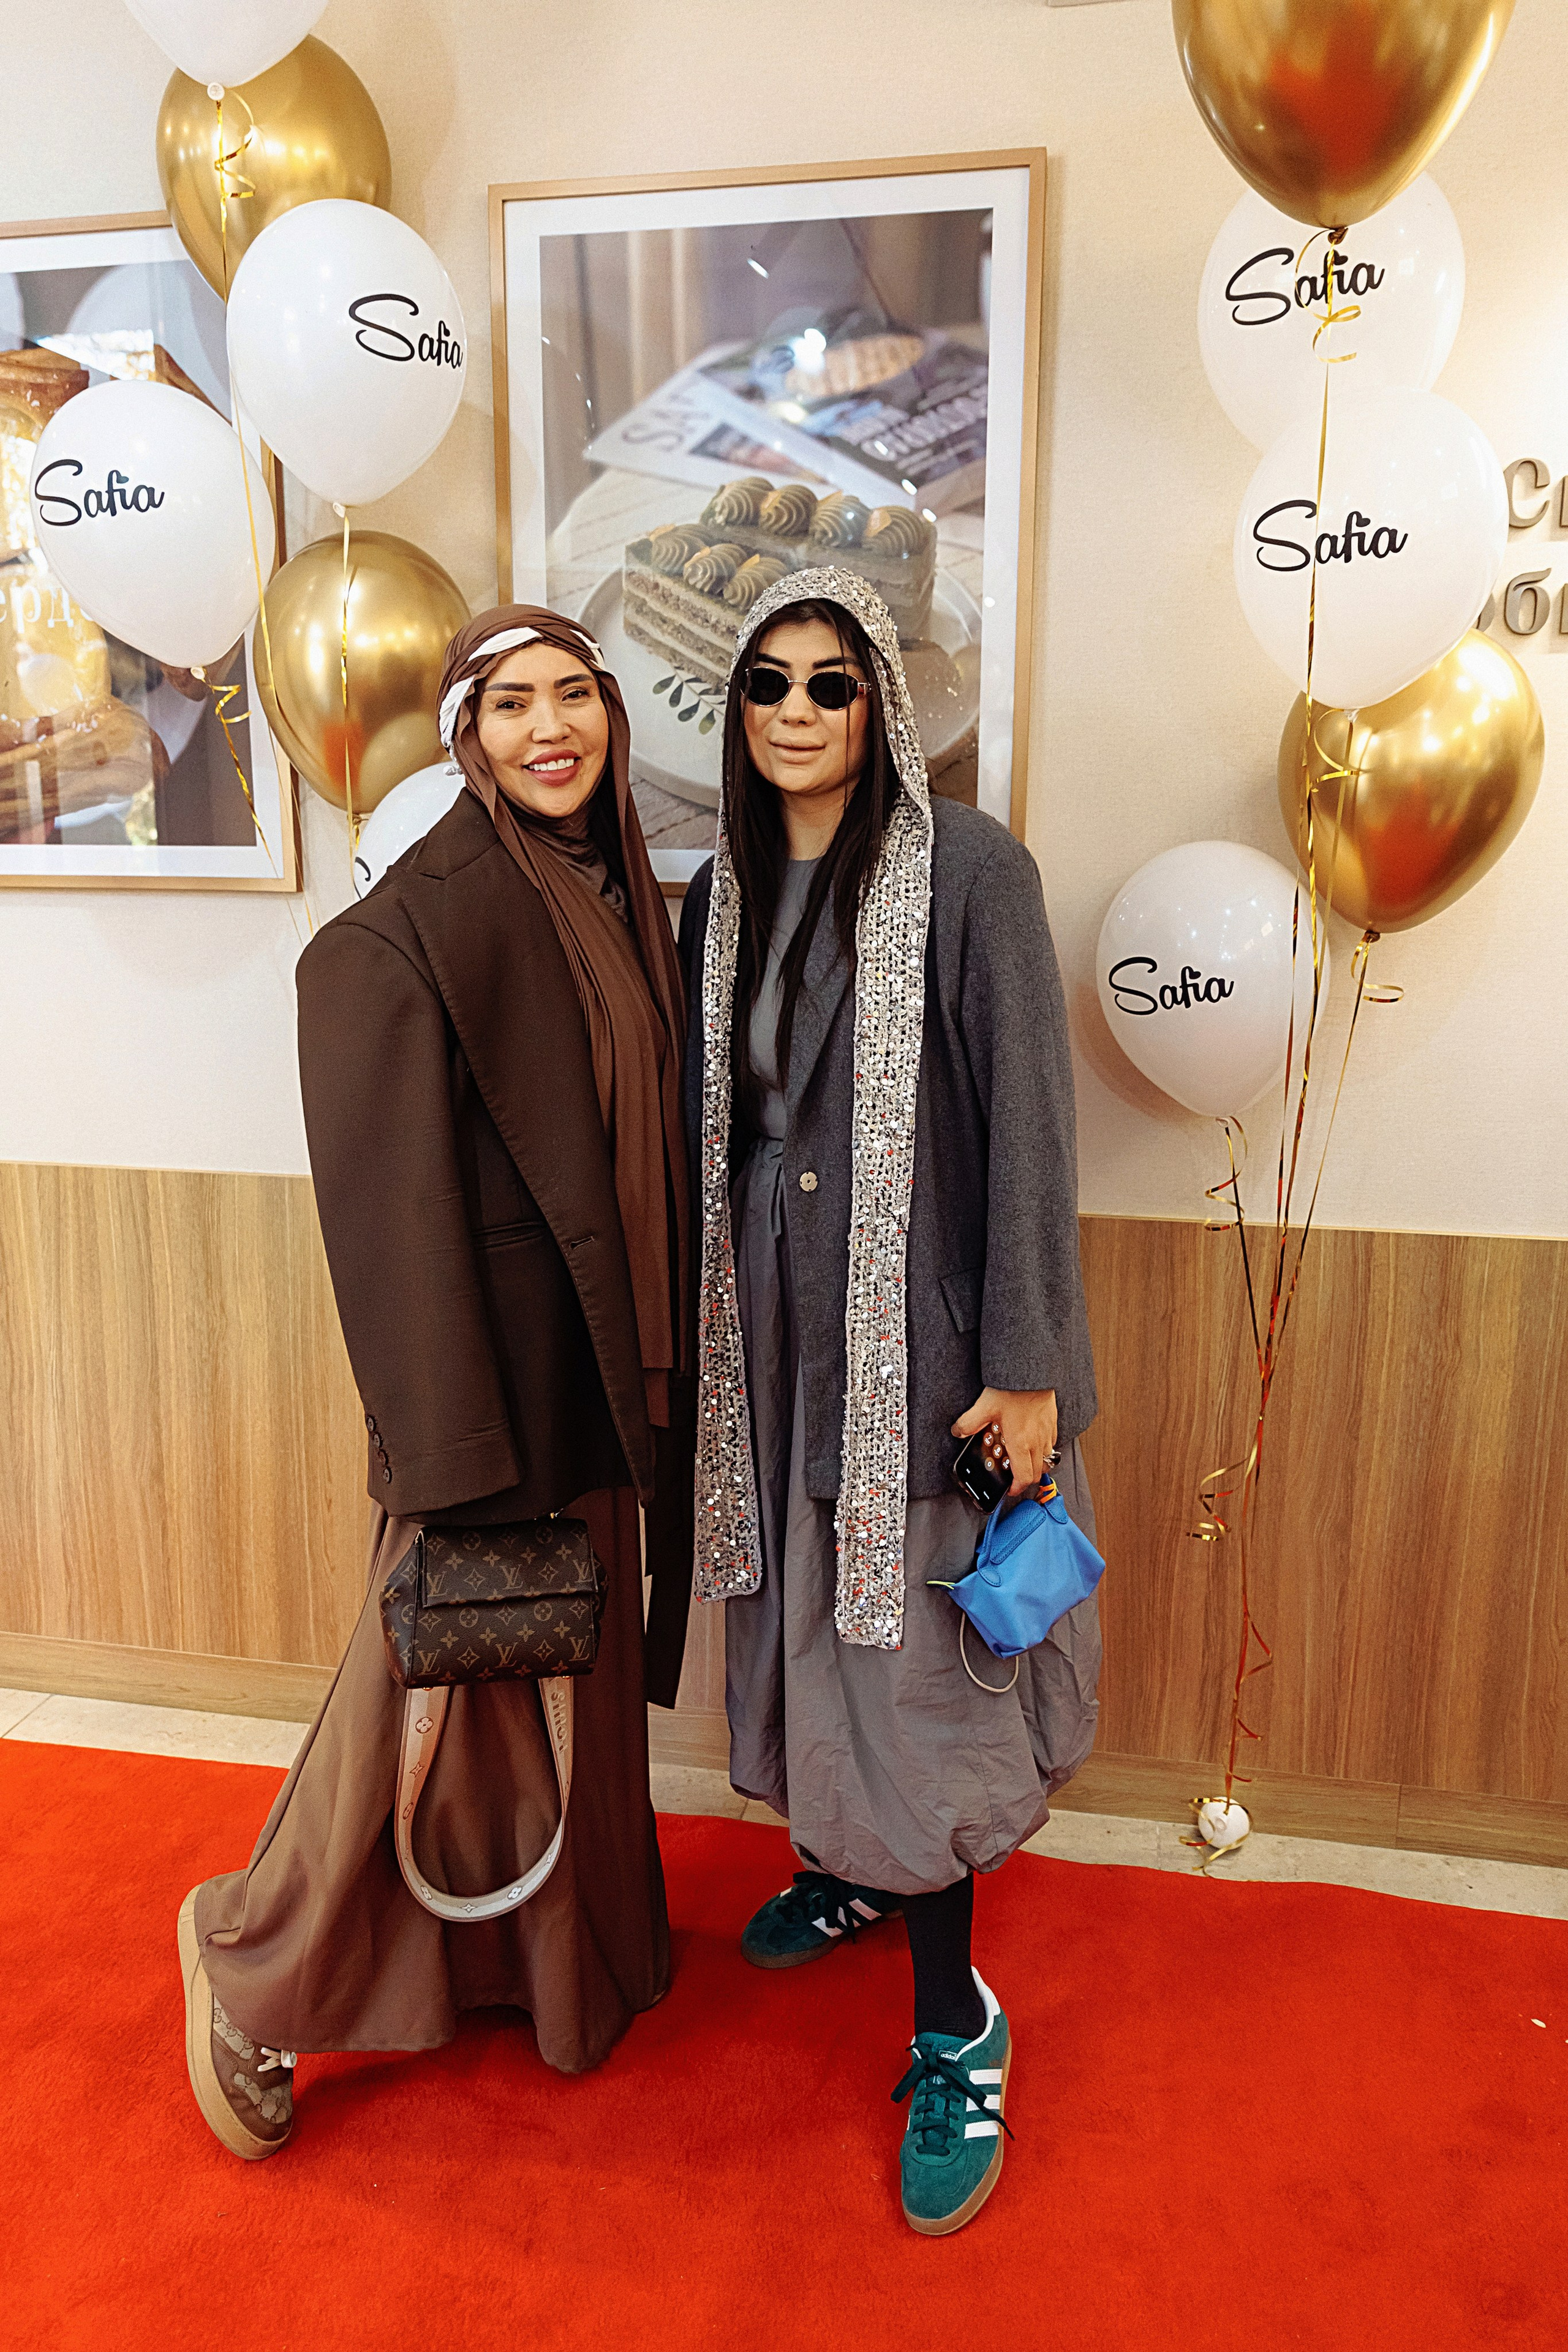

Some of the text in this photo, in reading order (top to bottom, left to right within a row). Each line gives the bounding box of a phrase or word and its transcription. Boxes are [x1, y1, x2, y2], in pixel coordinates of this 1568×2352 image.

[1225, 247, 1385, 326] Safia
[349, 293, 463, 369] Safia
[34, 459, 165, 527] Safia
[1253, 499, 1409, 572] Safia
[1108, 956, 1235, 1016] Safia
